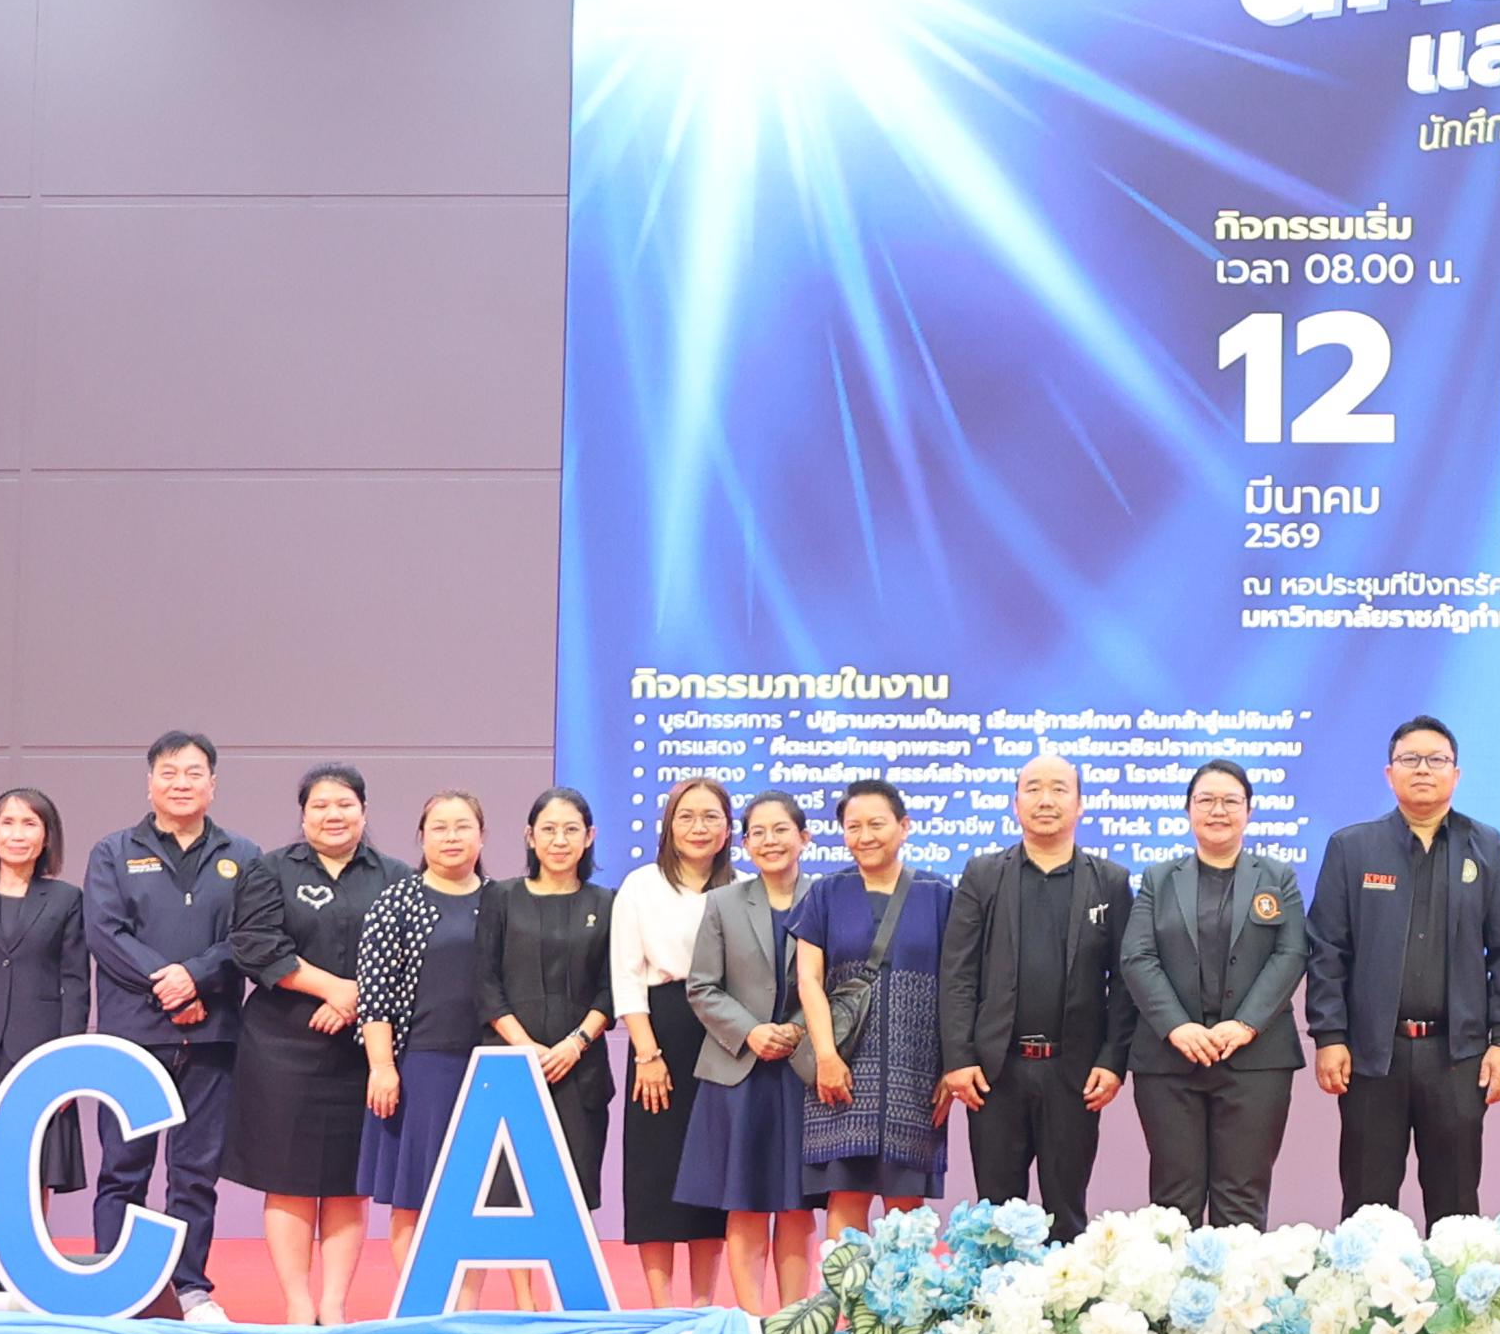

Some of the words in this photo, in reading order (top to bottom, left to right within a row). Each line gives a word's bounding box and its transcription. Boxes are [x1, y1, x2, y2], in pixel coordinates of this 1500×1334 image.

[1214, 202, 1413, 241] กิจกรรมเริ่ม
[1216, 258, 1290, 284] เวลา
[1304, 253, 1415, 284] 08.00
[1429, 258, 1461, 284] น.
[1218, 310, 1396, 443] 12
[1244, 474, 1381, 515] มีนาคม
[1243, 522, 1321, 549] 2569
[1242, 575, 1271, 597] ณ
[630, 666, 949, 700] กิจกรรมภายในงาน
[658, 710, 783, 734] บูธนิทรรศการ
[658, 739, 747, 756] การแสดง
[993, 737, 1033, 756] โดย
[1082, 764, 1120, 783] โดย
[1102, 819, 1152, 837] Trick
